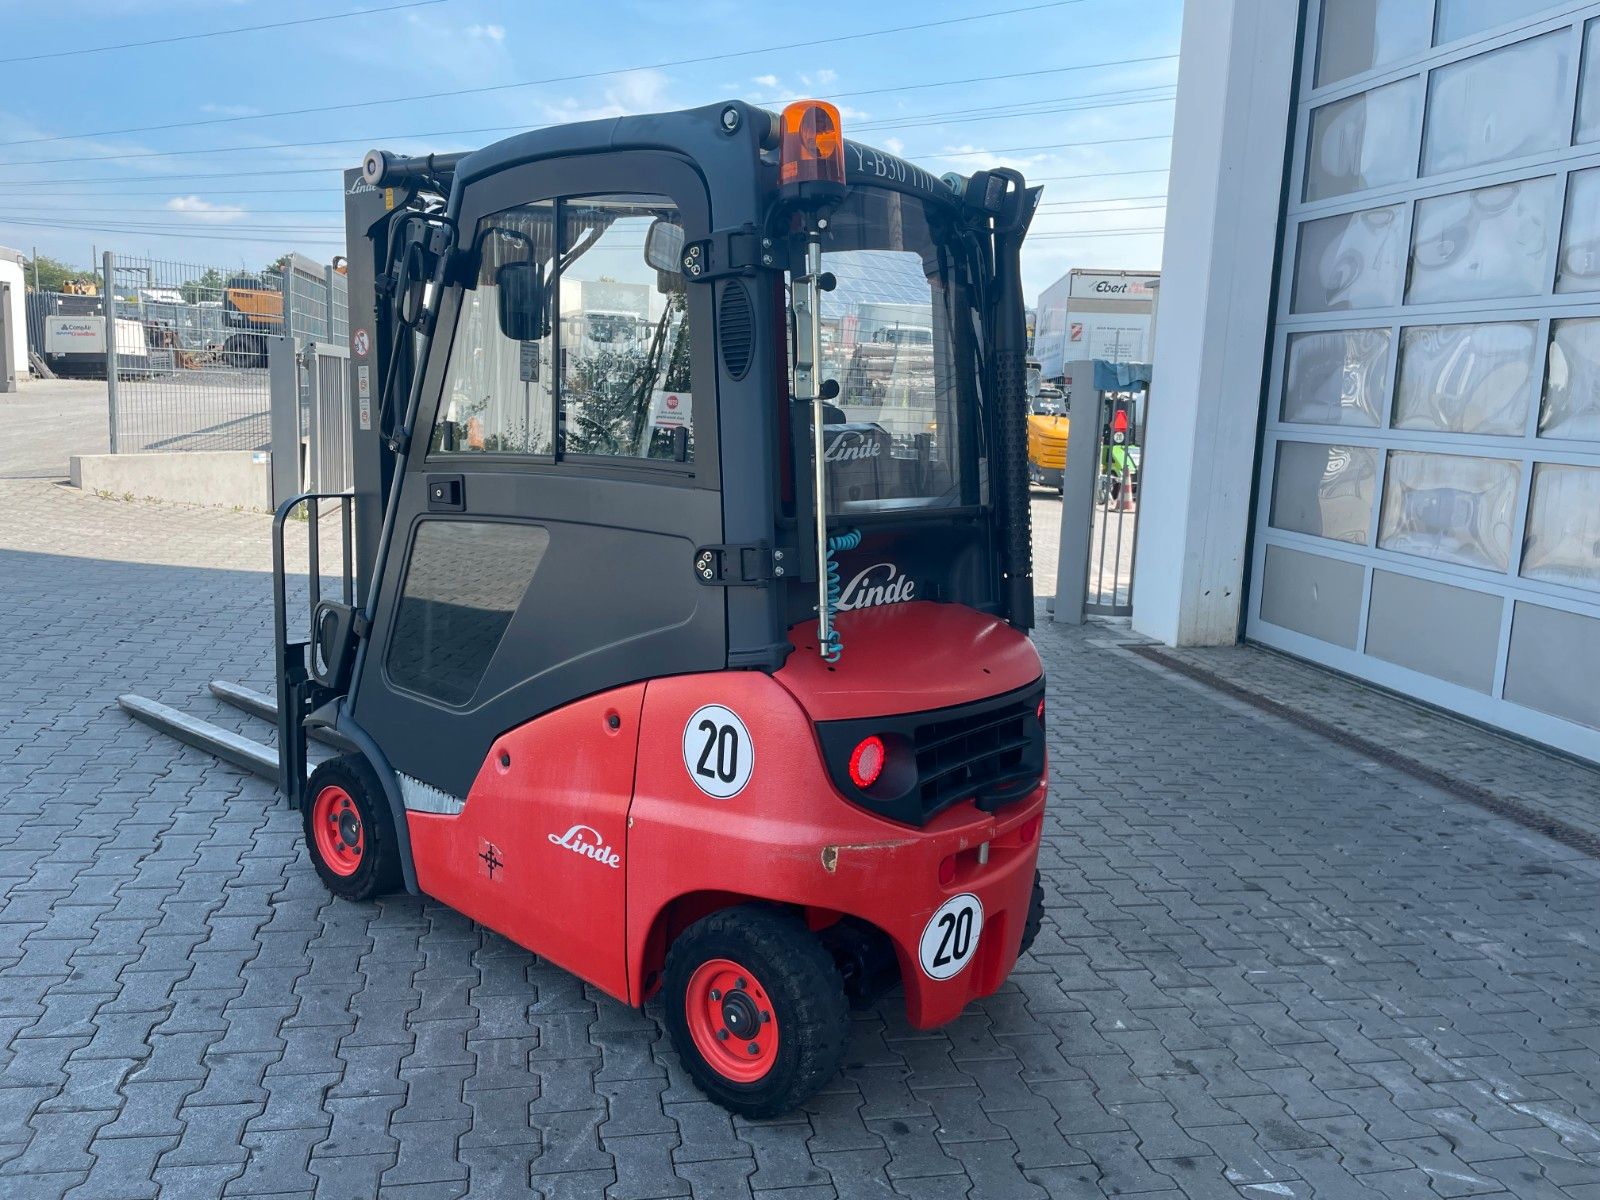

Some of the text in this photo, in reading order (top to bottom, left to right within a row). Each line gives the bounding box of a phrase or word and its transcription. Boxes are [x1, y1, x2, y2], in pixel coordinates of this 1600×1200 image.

[1096, 281, 1128, 293] Ebert
[823, 431, 881, 462] Linde
[836, 563, 915, 611] Linde
[696, 719, 739, 783] 20
[548, 824, 620, 869] Linde
[932, 906, 974, 968] 20
